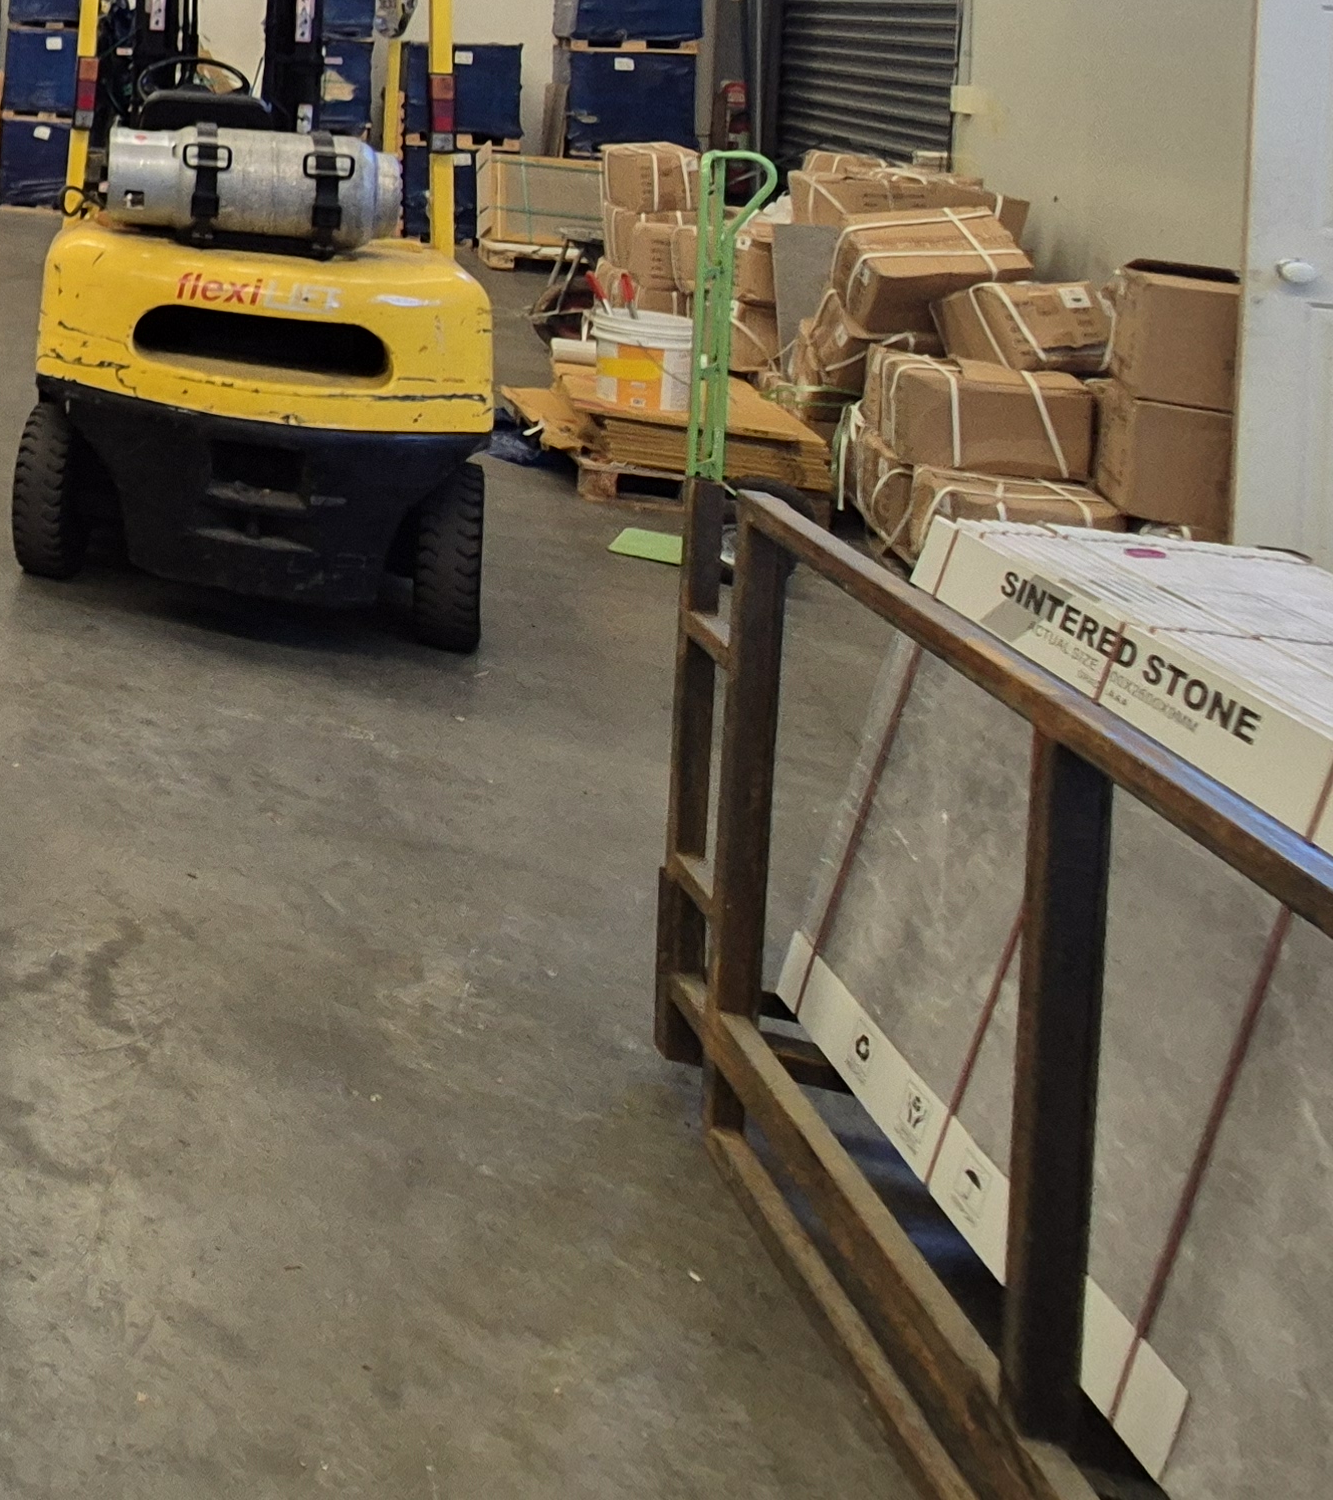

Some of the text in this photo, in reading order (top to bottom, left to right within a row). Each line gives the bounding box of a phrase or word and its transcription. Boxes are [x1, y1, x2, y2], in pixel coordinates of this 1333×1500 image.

[1000, 571, 1263, 746] SINTERED STONE
[1027, 620, 1069, 656] ACTUAL
[1071, 647, 1100, 673] SIZE
